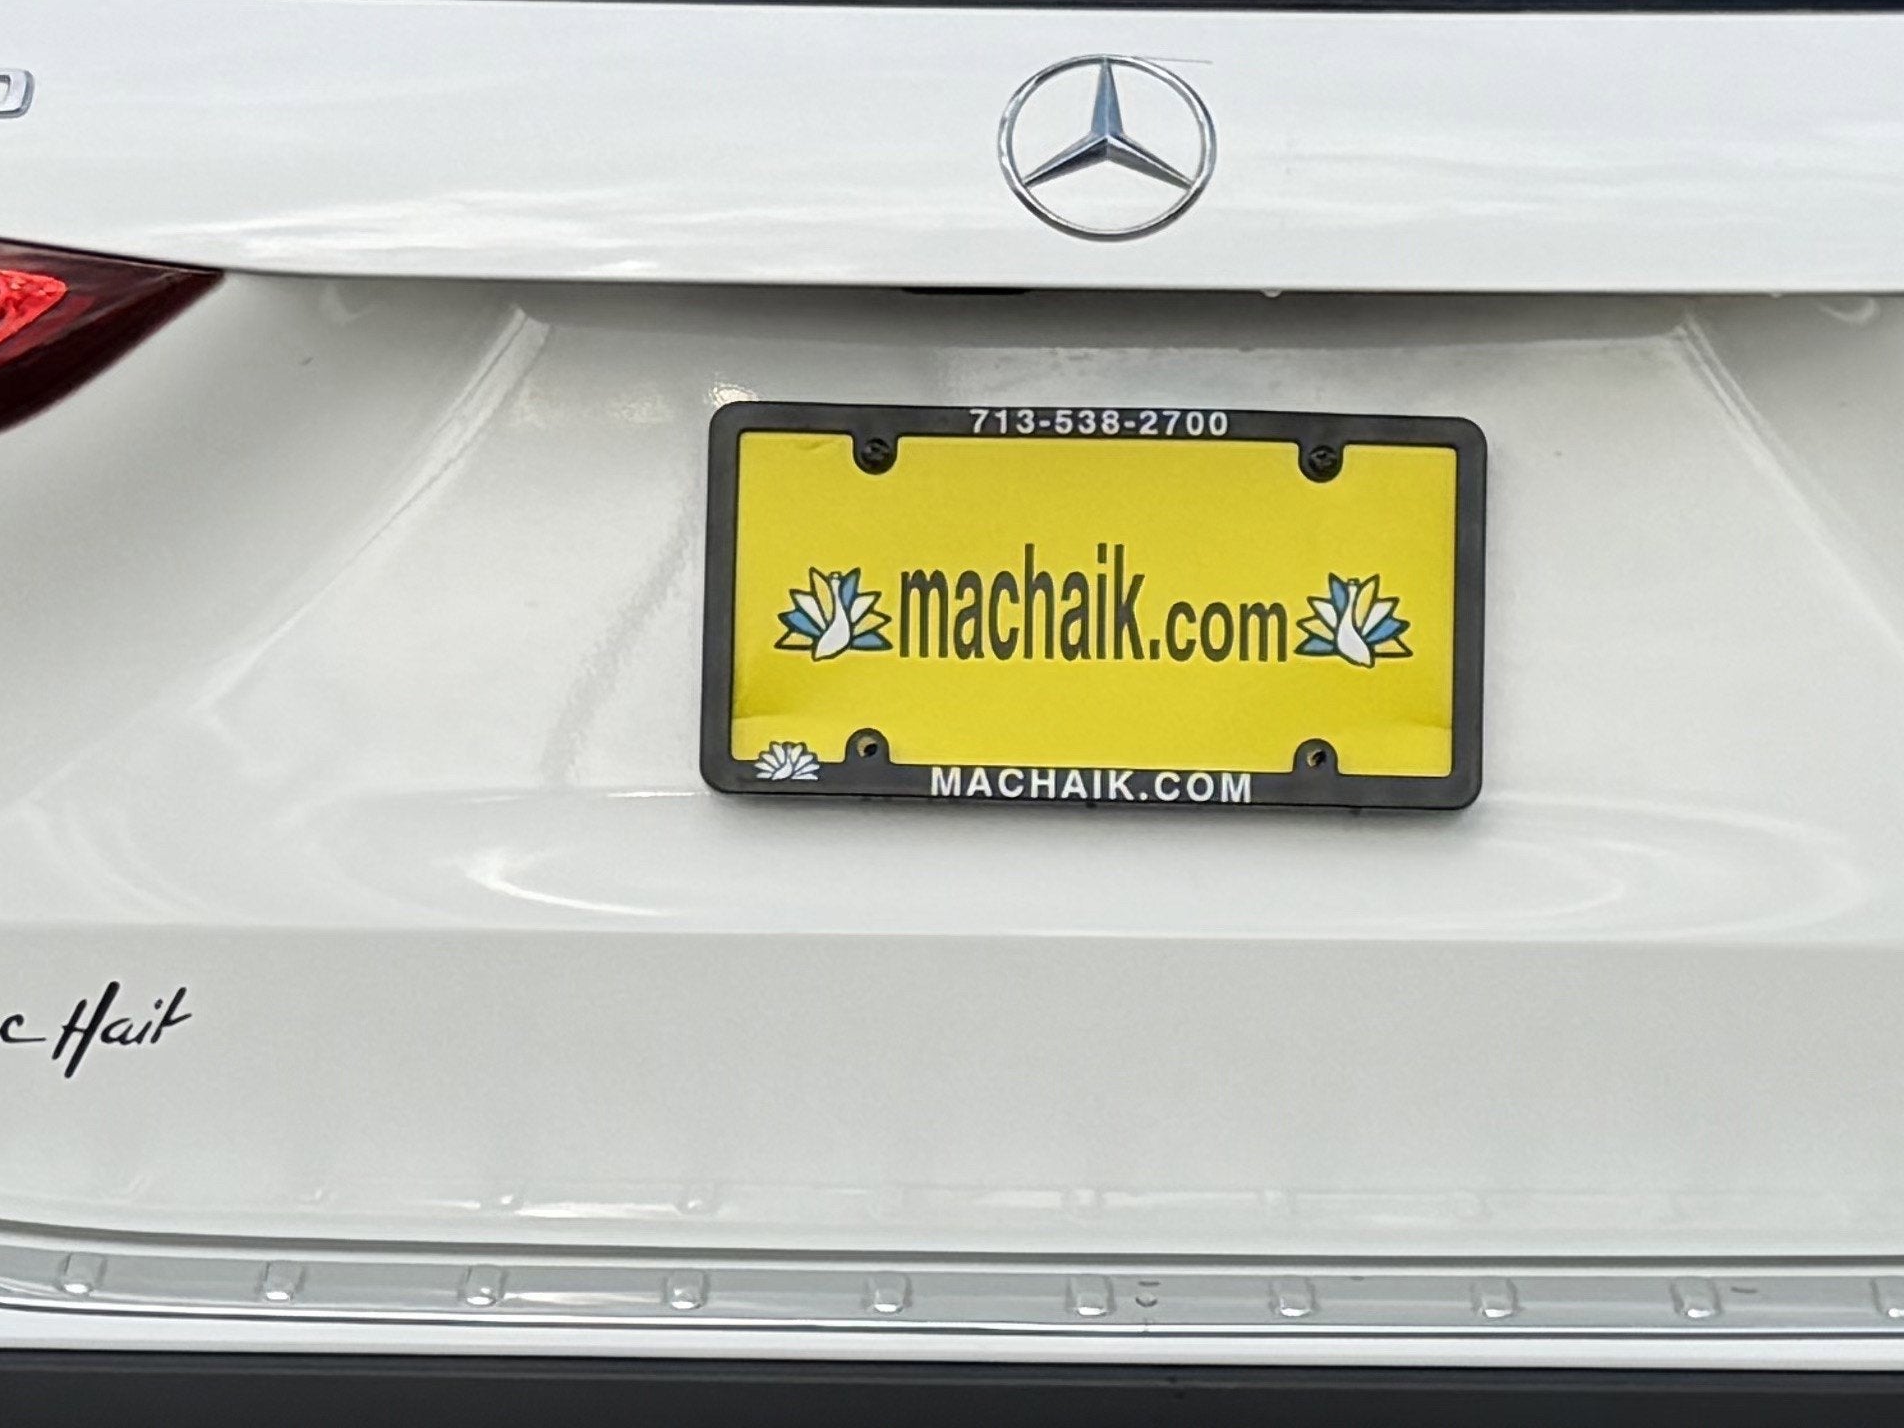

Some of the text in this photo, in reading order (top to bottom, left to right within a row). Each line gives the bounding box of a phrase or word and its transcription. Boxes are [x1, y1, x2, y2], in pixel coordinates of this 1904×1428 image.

[969, 408, 1229, 436] 713-538-2700
[900, 544, 1288, 662] machaik.com
[930, 766, 1253, 803] MACHAIK.COM
